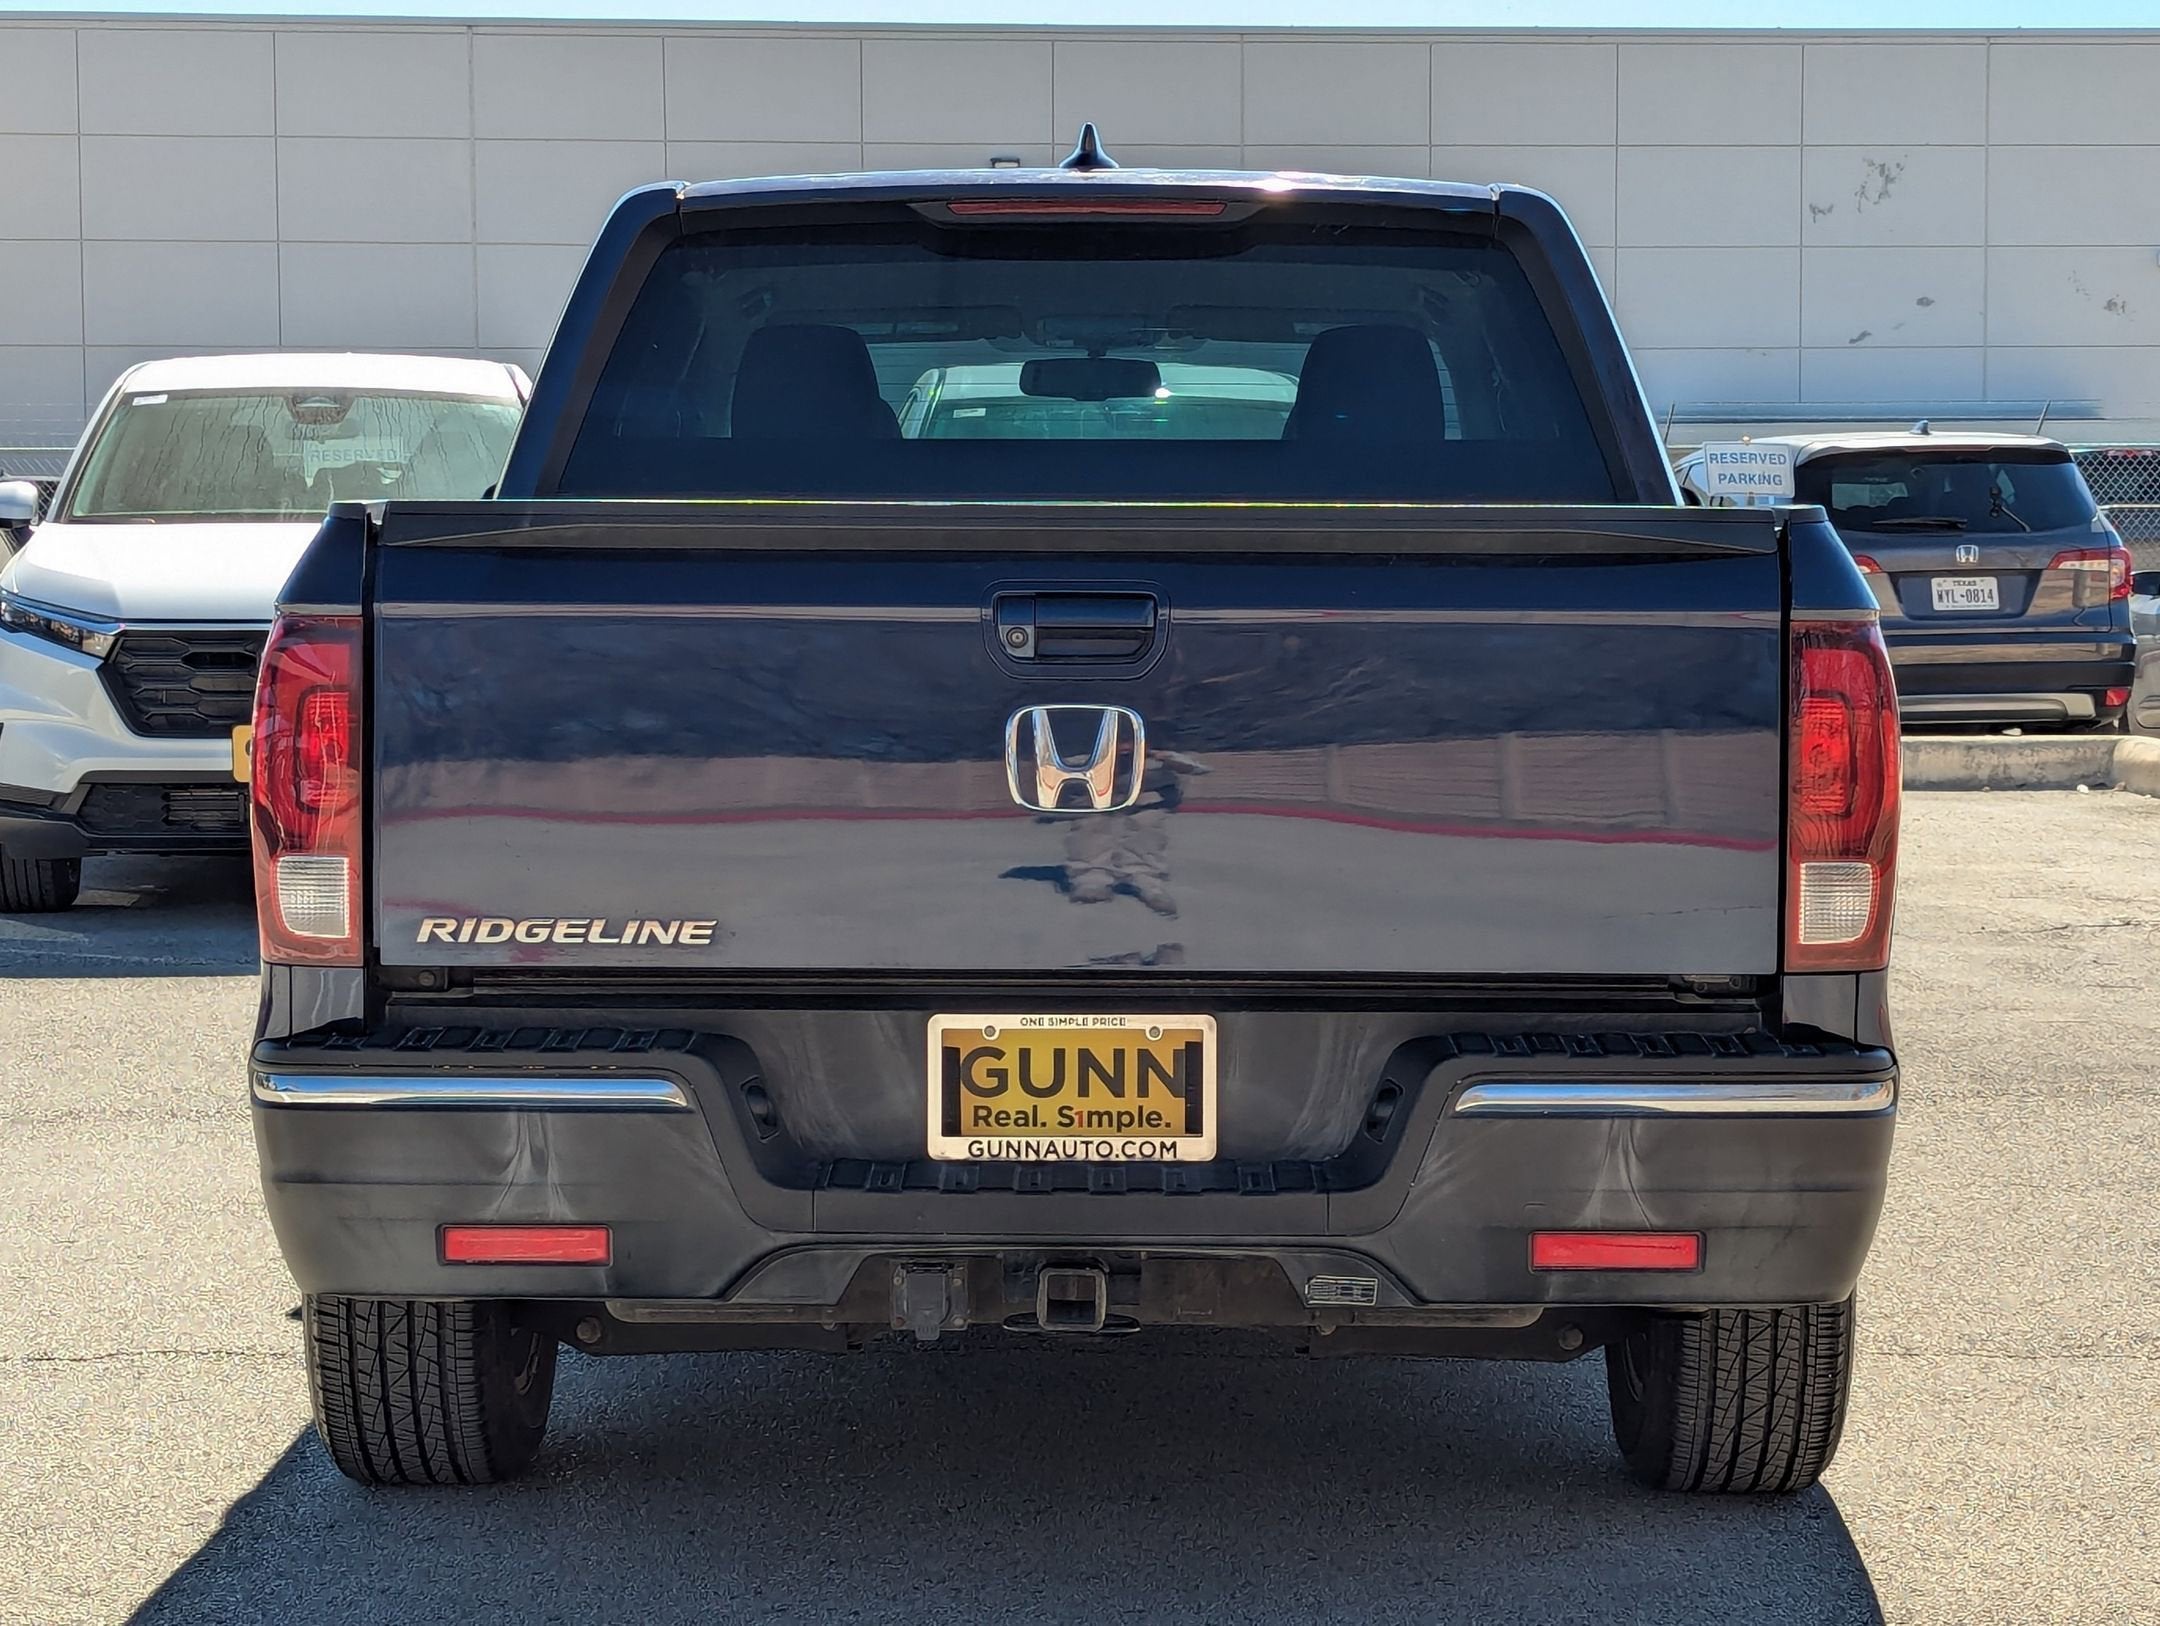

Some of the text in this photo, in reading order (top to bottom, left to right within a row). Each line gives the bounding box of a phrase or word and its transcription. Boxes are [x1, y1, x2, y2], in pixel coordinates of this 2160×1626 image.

[1709, 452, 1787, 465] RESERVED
[1718, 472, 1783, 486] PARKING
[416, 917, 718, 945] RIDGELINE
[1020, 1017, 1127, 1027] ONE SIMPLE PRICE
[960, 1046, 1187, 1099] GUNN
[972, 1105, 1047, 1128] Real.
[967, 1140, 1178, 1160] GUNNAUTO.COM
